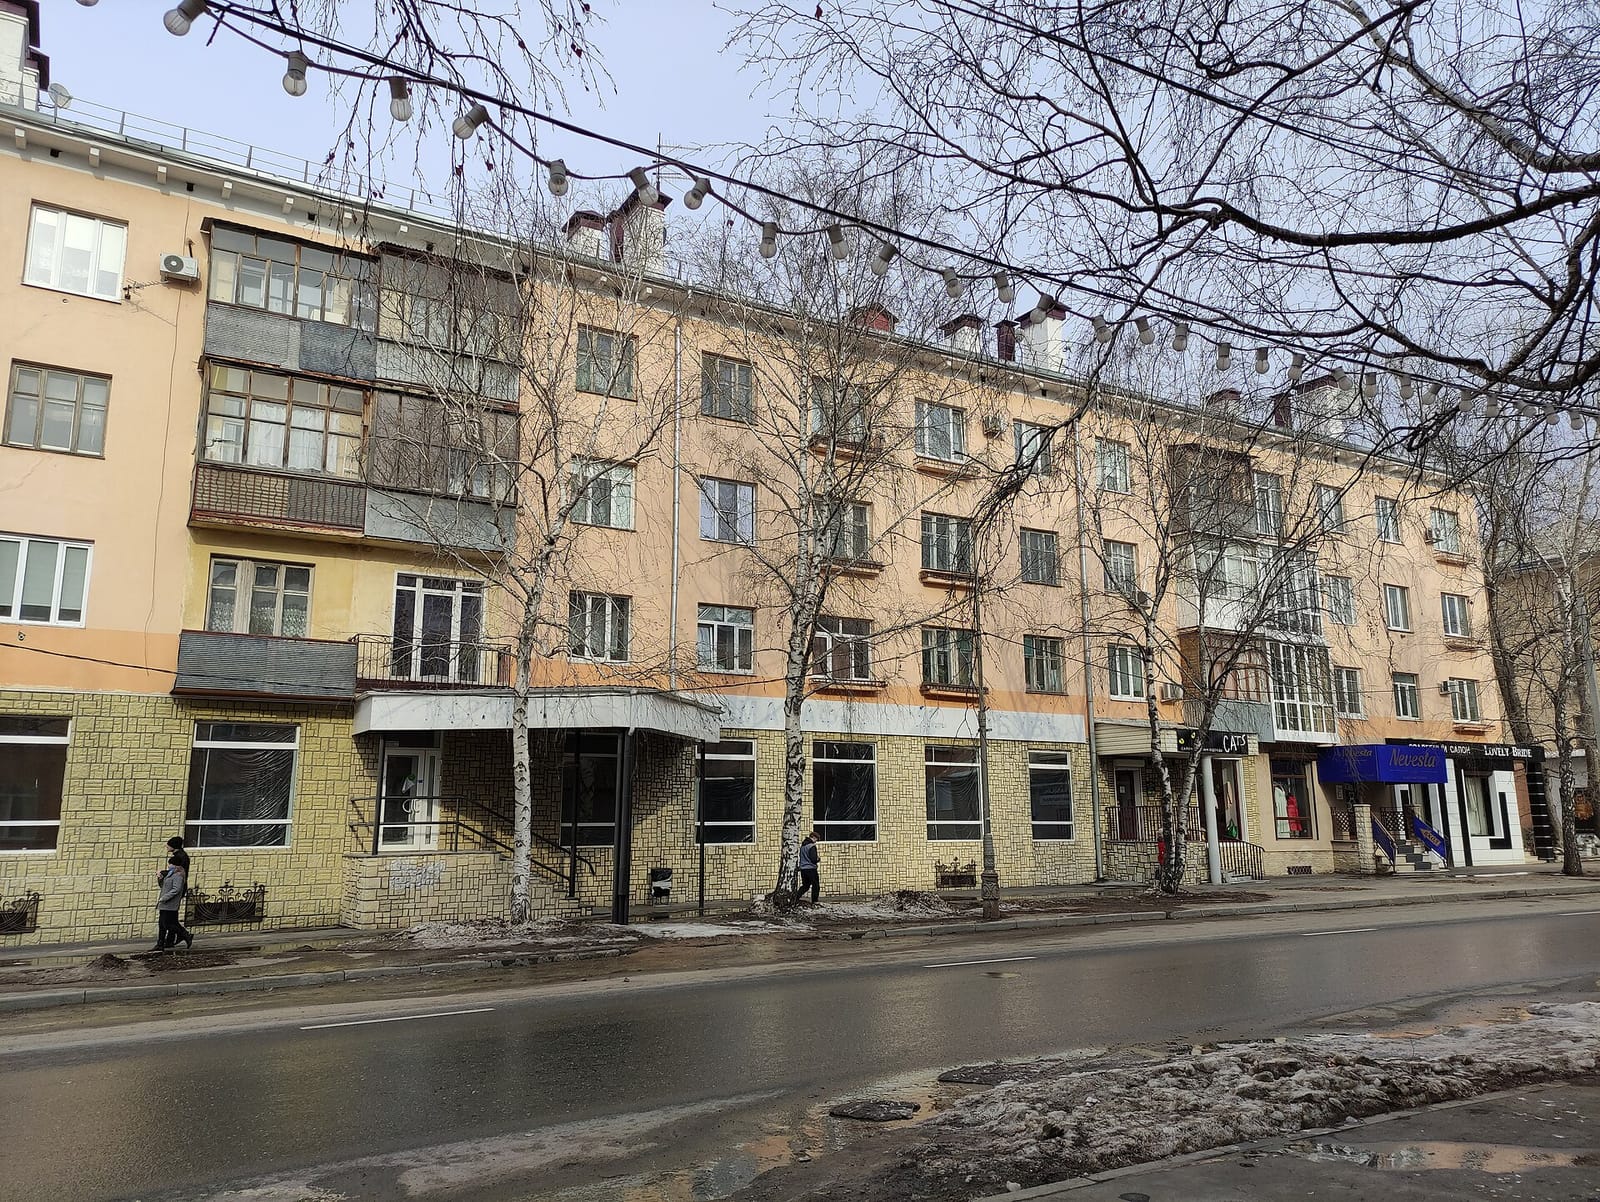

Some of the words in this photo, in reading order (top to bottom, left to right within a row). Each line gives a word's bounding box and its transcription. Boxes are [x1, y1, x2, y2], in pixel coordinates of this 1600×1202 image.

[1223, 734, 1246, 753] CATS
[1484, 745, 1509, 757] LOVELY
[1512, 747, 1533, 758] BRIDE
[1389, 748, 1436, 768] Nevesta
